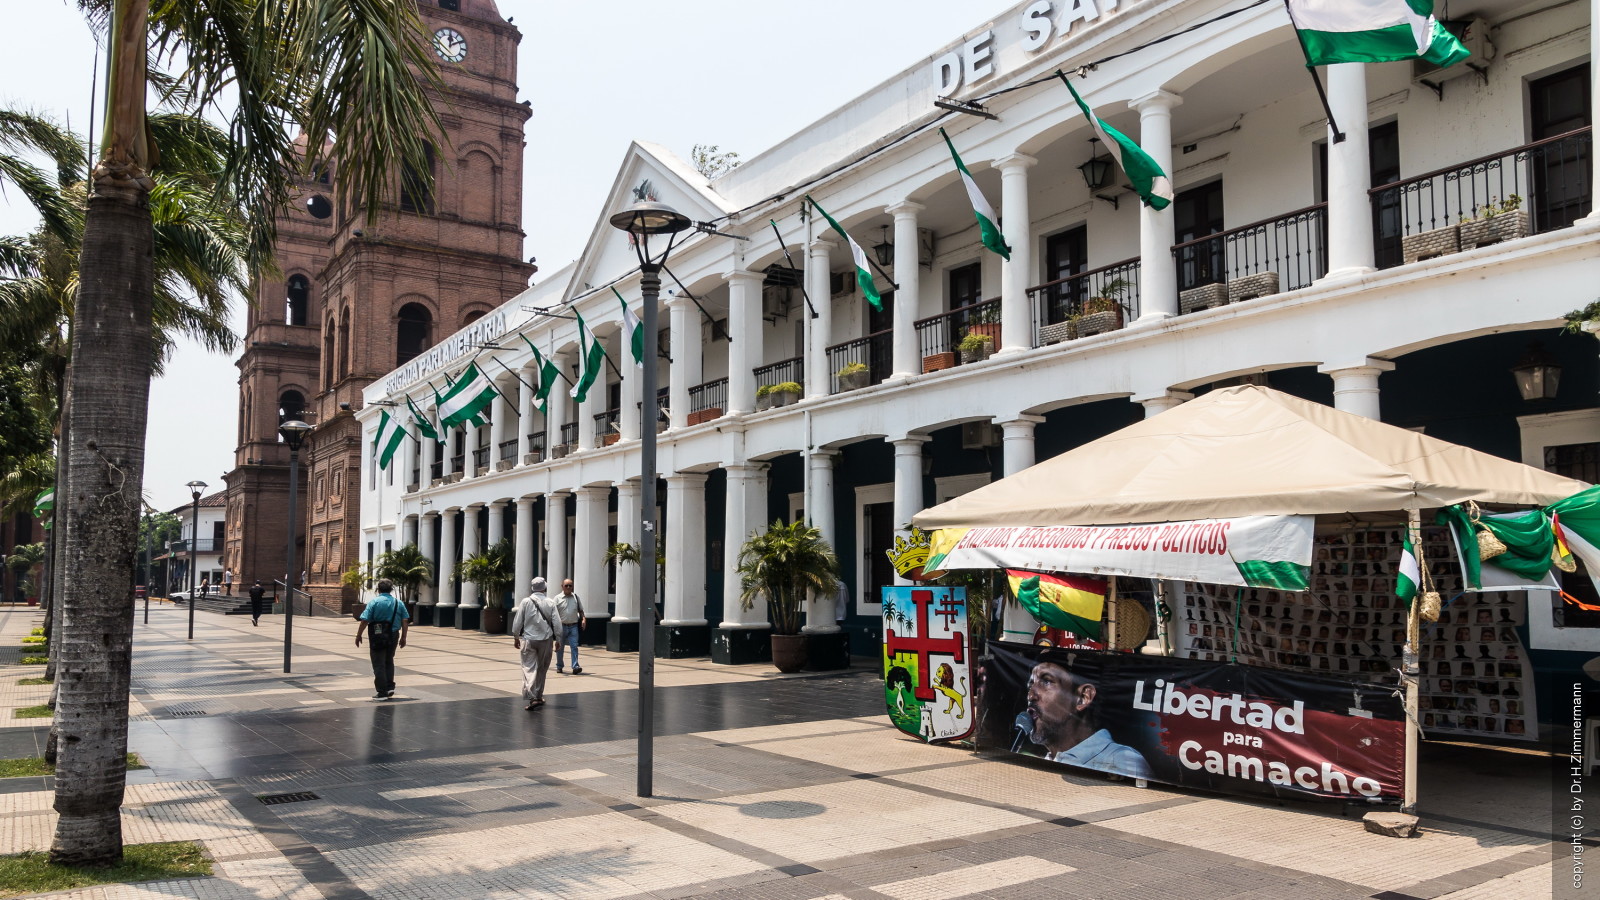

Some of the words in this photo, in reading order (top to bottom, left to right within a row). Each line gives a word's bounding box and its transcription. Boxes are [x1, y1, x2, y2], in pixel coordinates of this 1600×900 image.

[933, 29, 993, 97] DE
[1021, 0, 1118, 53] SA
[386, 361, 420, 393] BRIGADA
[420, 311, 506, 377] PARLAMENTARIA
[1011, 527, 1091, 549] PERSEGUIDOS
[1090, 527, 1105, 549] Y
[1100, 525, 1160, 551] PRESOS
[1152, 519, 1231, 556] POLÍTICOS
[1133, 678, 1305, 735] Libertad
[1178, 740, 1382, 797] Camacho
[1223, 731, 1263, 749] para
